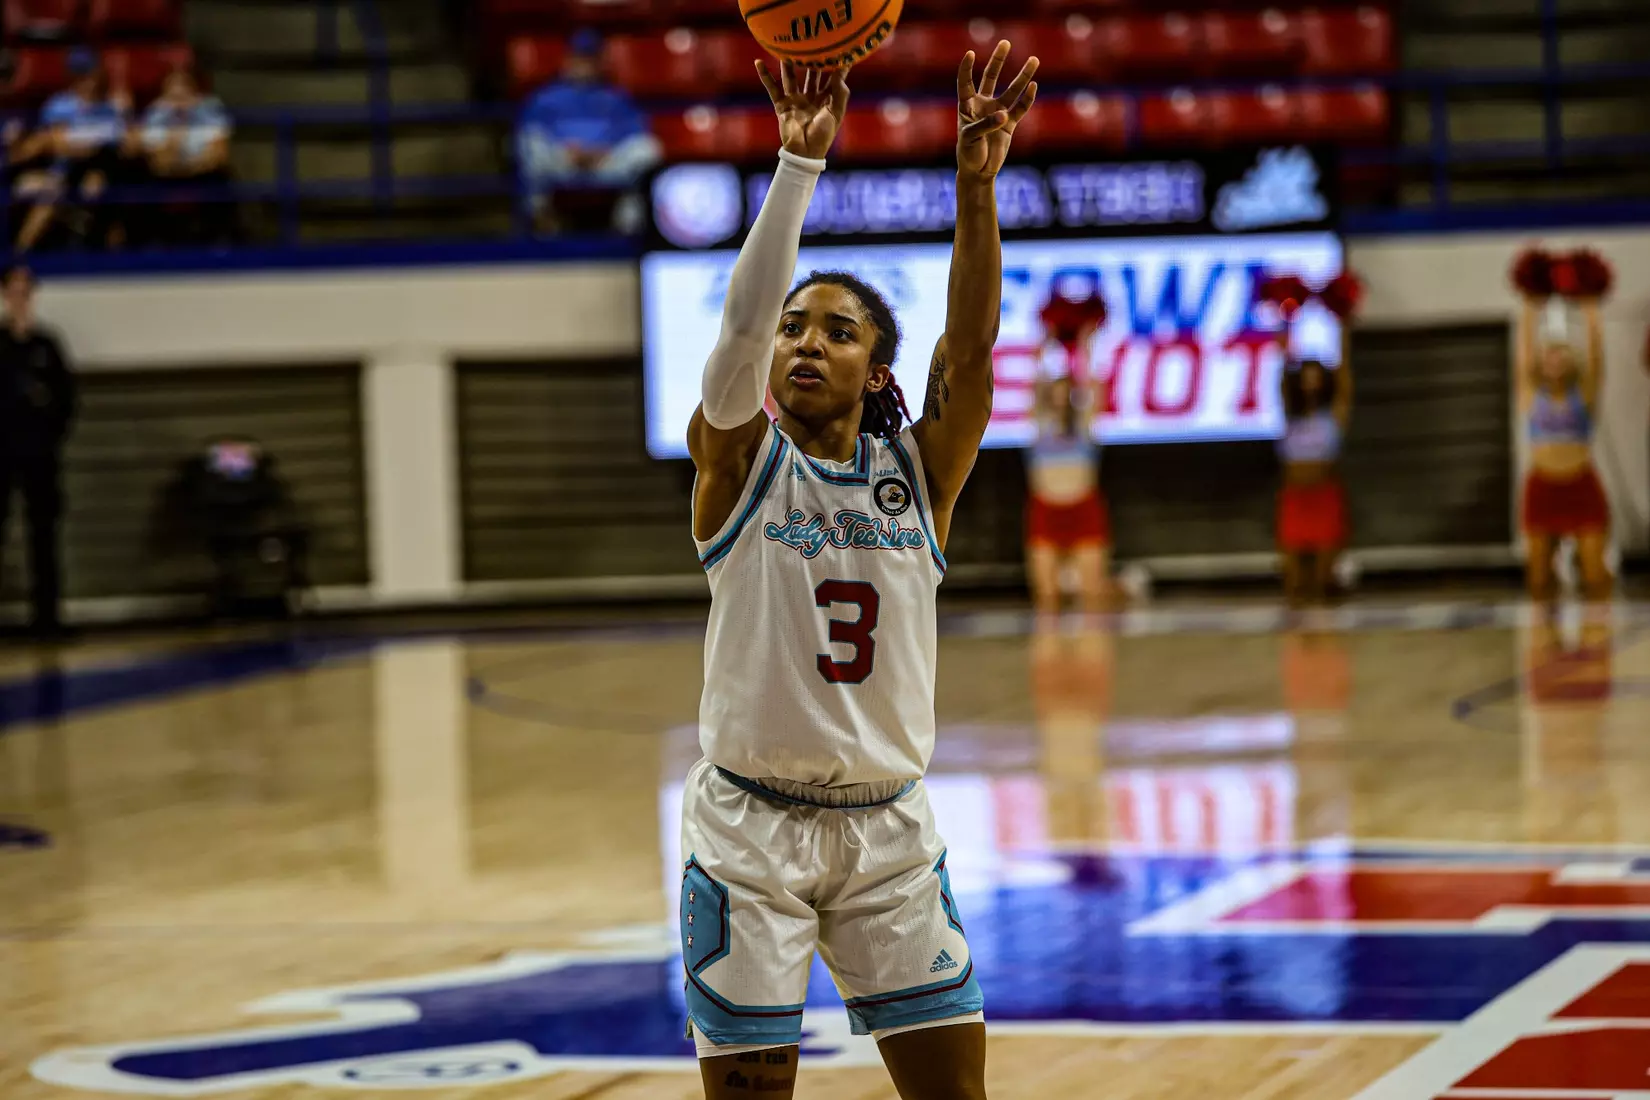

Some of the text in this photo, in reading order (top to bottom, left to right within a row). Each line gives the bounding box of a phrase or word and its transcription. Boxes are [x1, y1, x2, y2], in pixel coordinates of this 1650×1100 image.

[764, 506, 830, 559] Lady
[814, 578, 880, 684] 3
[929, 960, 958, 973] adidas
